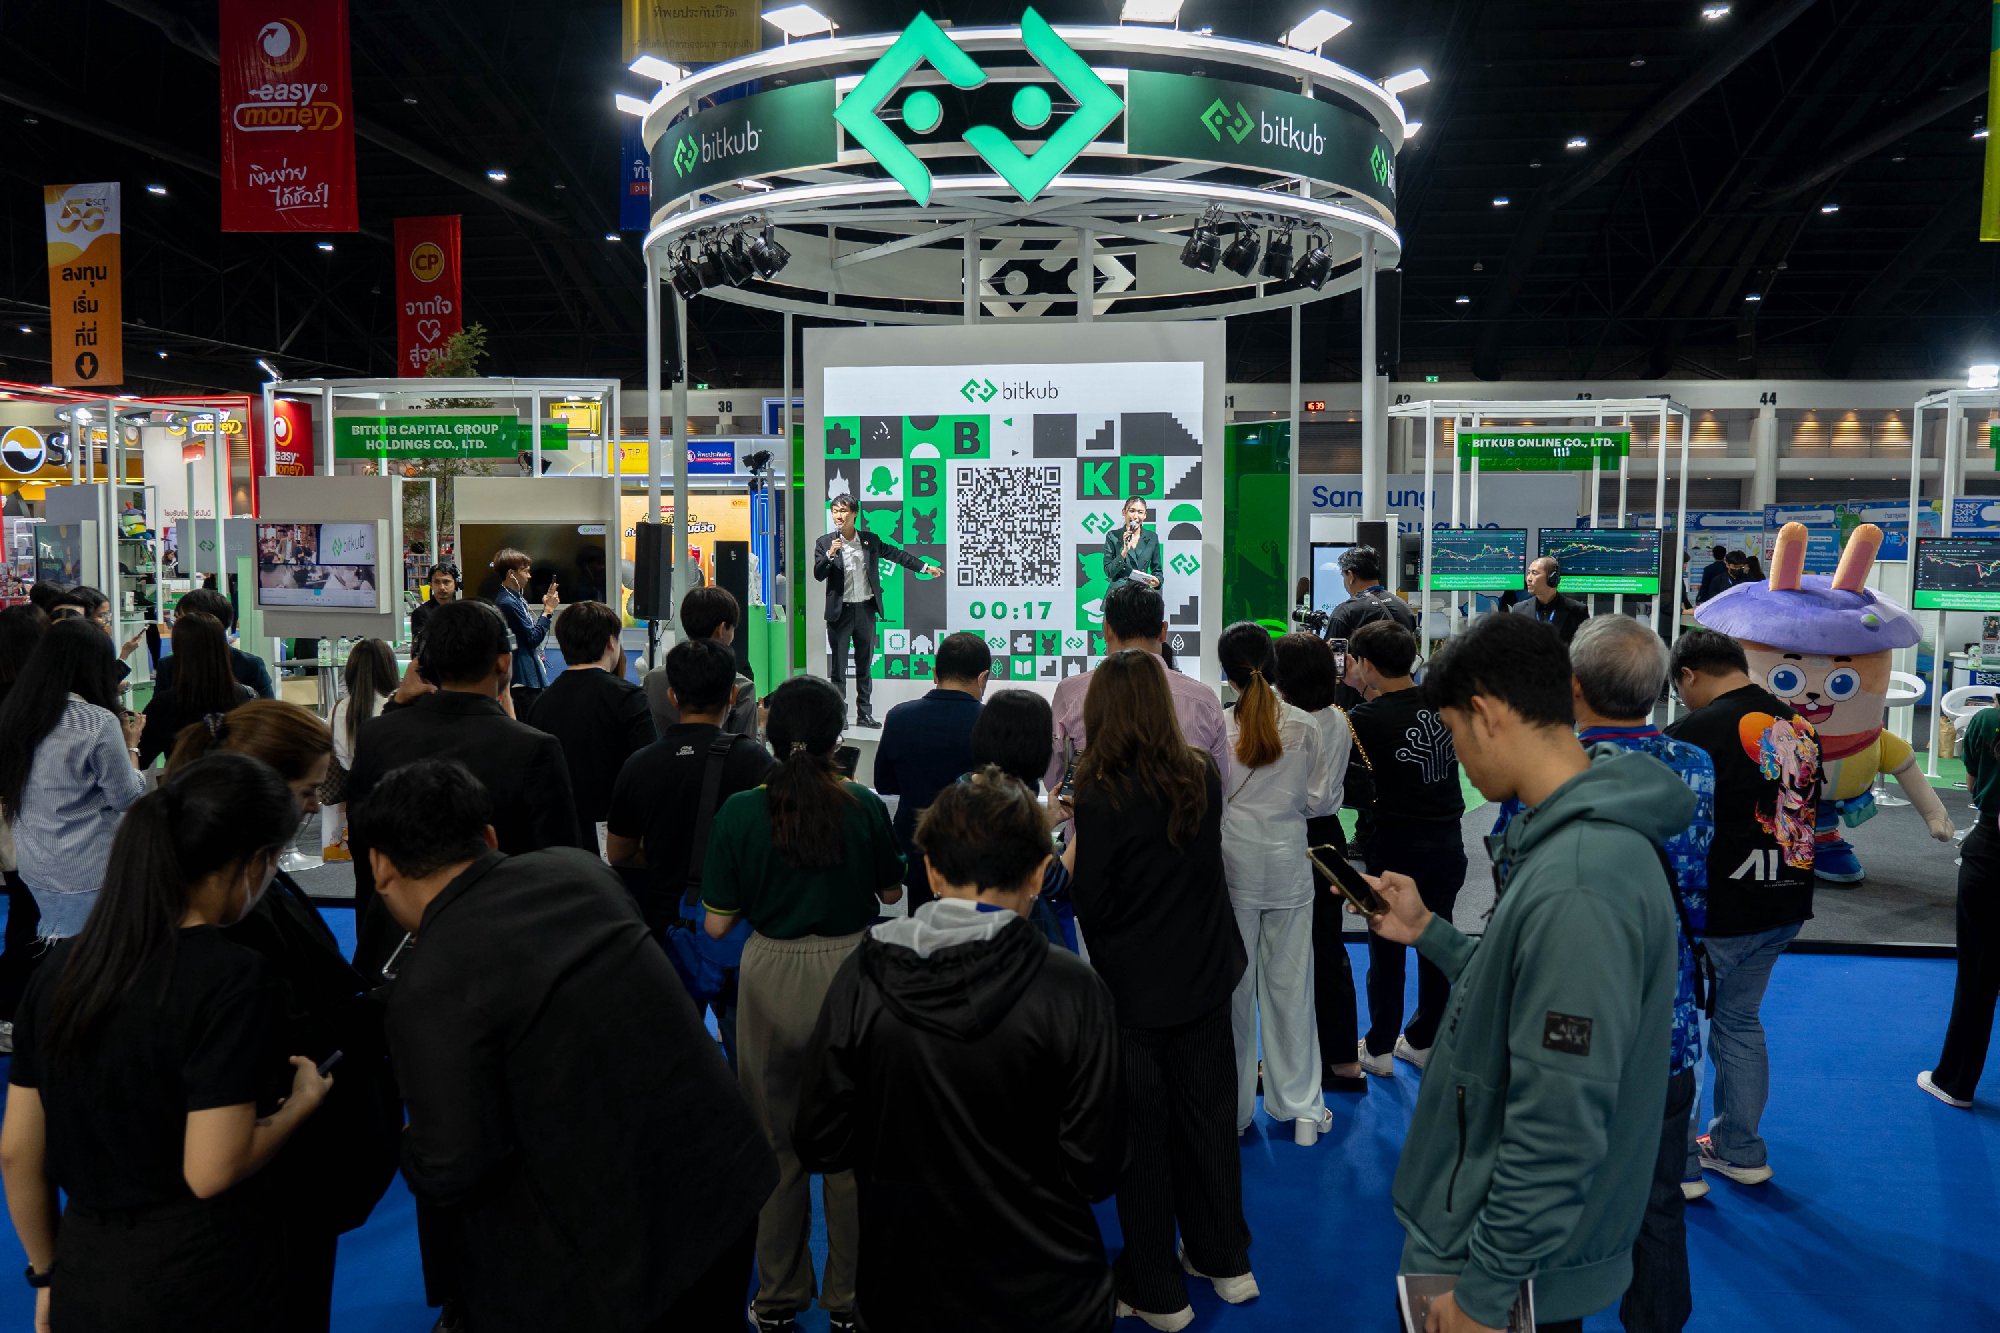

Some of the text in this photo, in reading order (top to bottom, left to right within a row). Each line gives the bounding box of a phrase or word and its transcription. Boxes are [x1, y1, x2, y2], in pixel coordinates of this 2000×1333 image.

[255, 83, 318, 106] easy
[245, 106, 329, 130] money
[702, 121, 760, 163] bitkub
[1261, 111, 1325, 155] bitkub
[415, 254, 439, 271] CP
[62, 265, 107, 288] ลงทุน
[405, 295, 453, 315] จากใจ
[1003, 380, 1059, 400] bitkub
[1760, 392, 1777, 406] 44
[351, 424, 499, 436] BITKUB CAPITAL GROUP
[366, 439, 487, 451] HOLDINGS CO., LTD.
[1473, 437, 1614, 449] BITKUB ONLINE CO., LTD.
[969, 601, 1052, 620] 00:17
